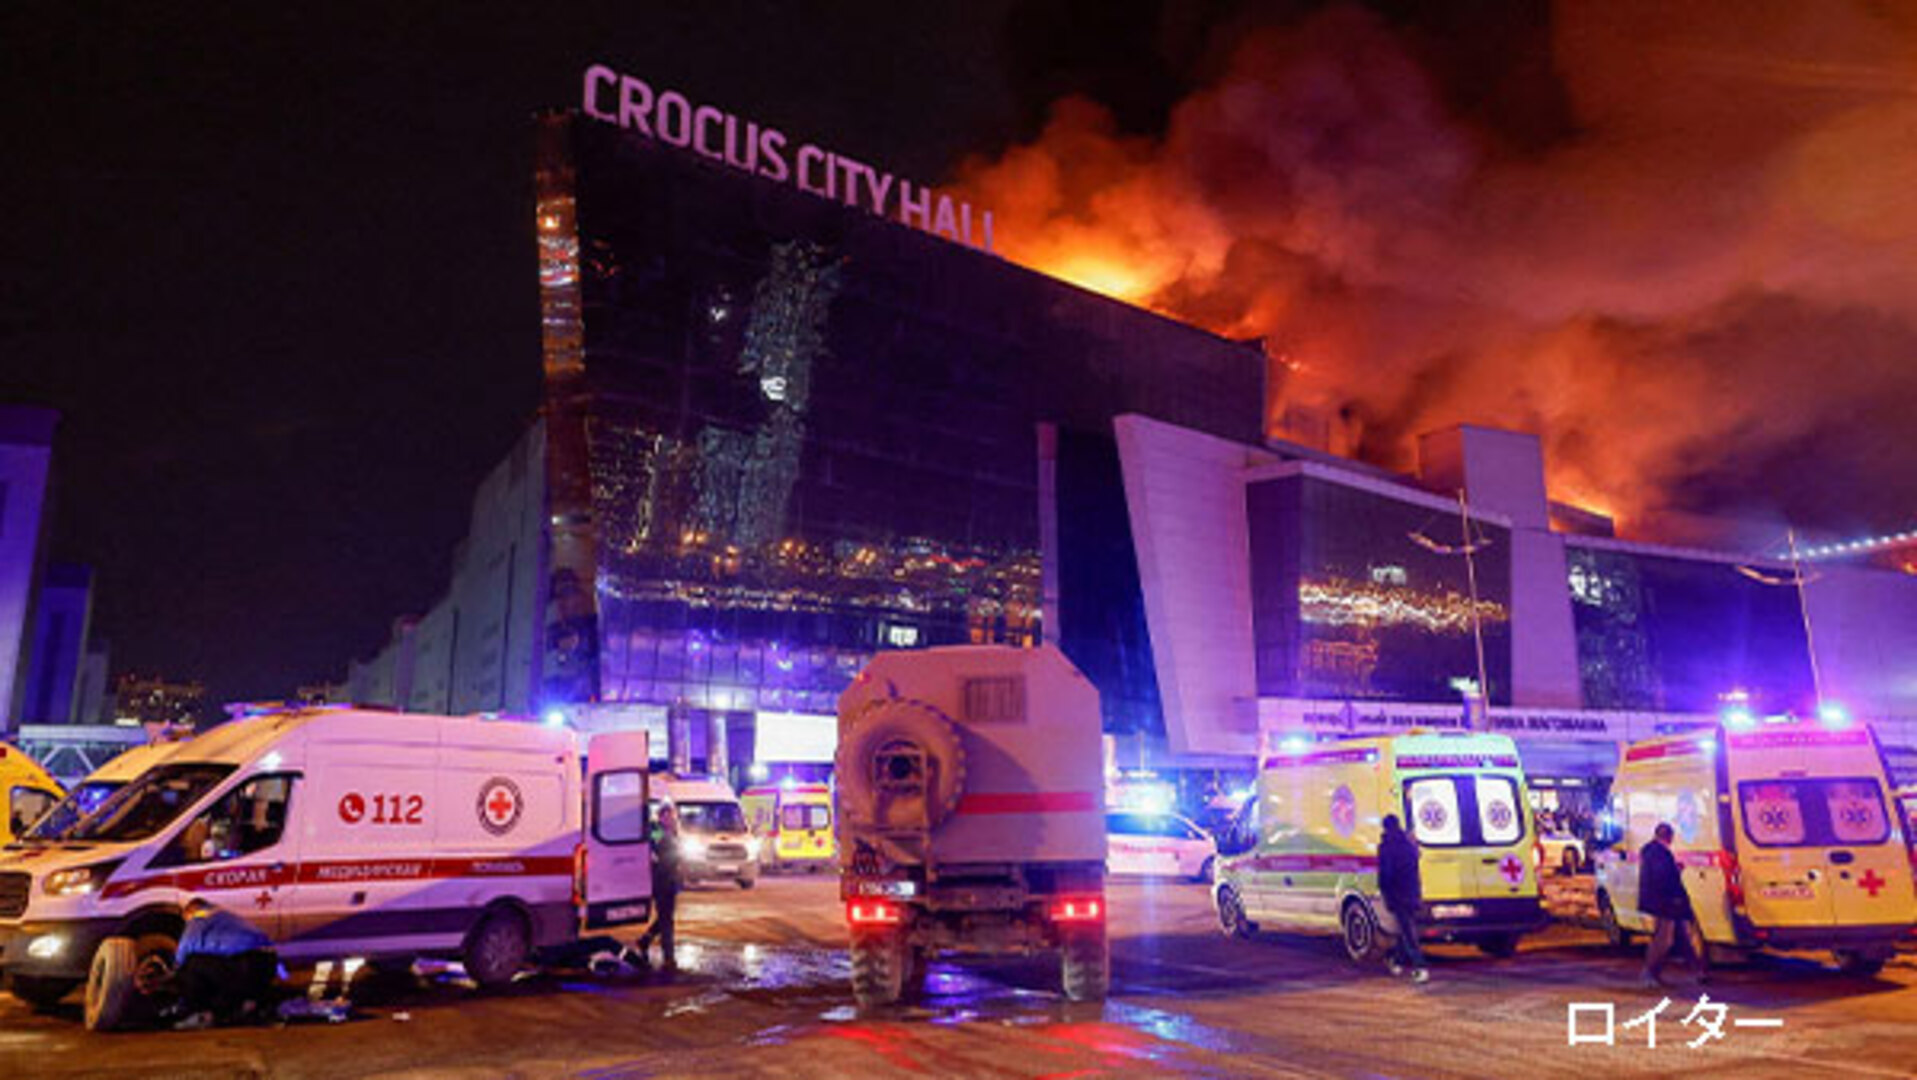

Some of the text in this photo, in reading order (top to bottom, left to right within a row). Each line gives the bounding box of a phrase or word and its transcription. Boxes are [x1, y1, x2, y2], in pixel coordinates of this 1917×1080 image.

[583, 64, 789, 182] CROCUS
[797, 144, 893, 215] CITY
[371, 793, 423, 824] 112
